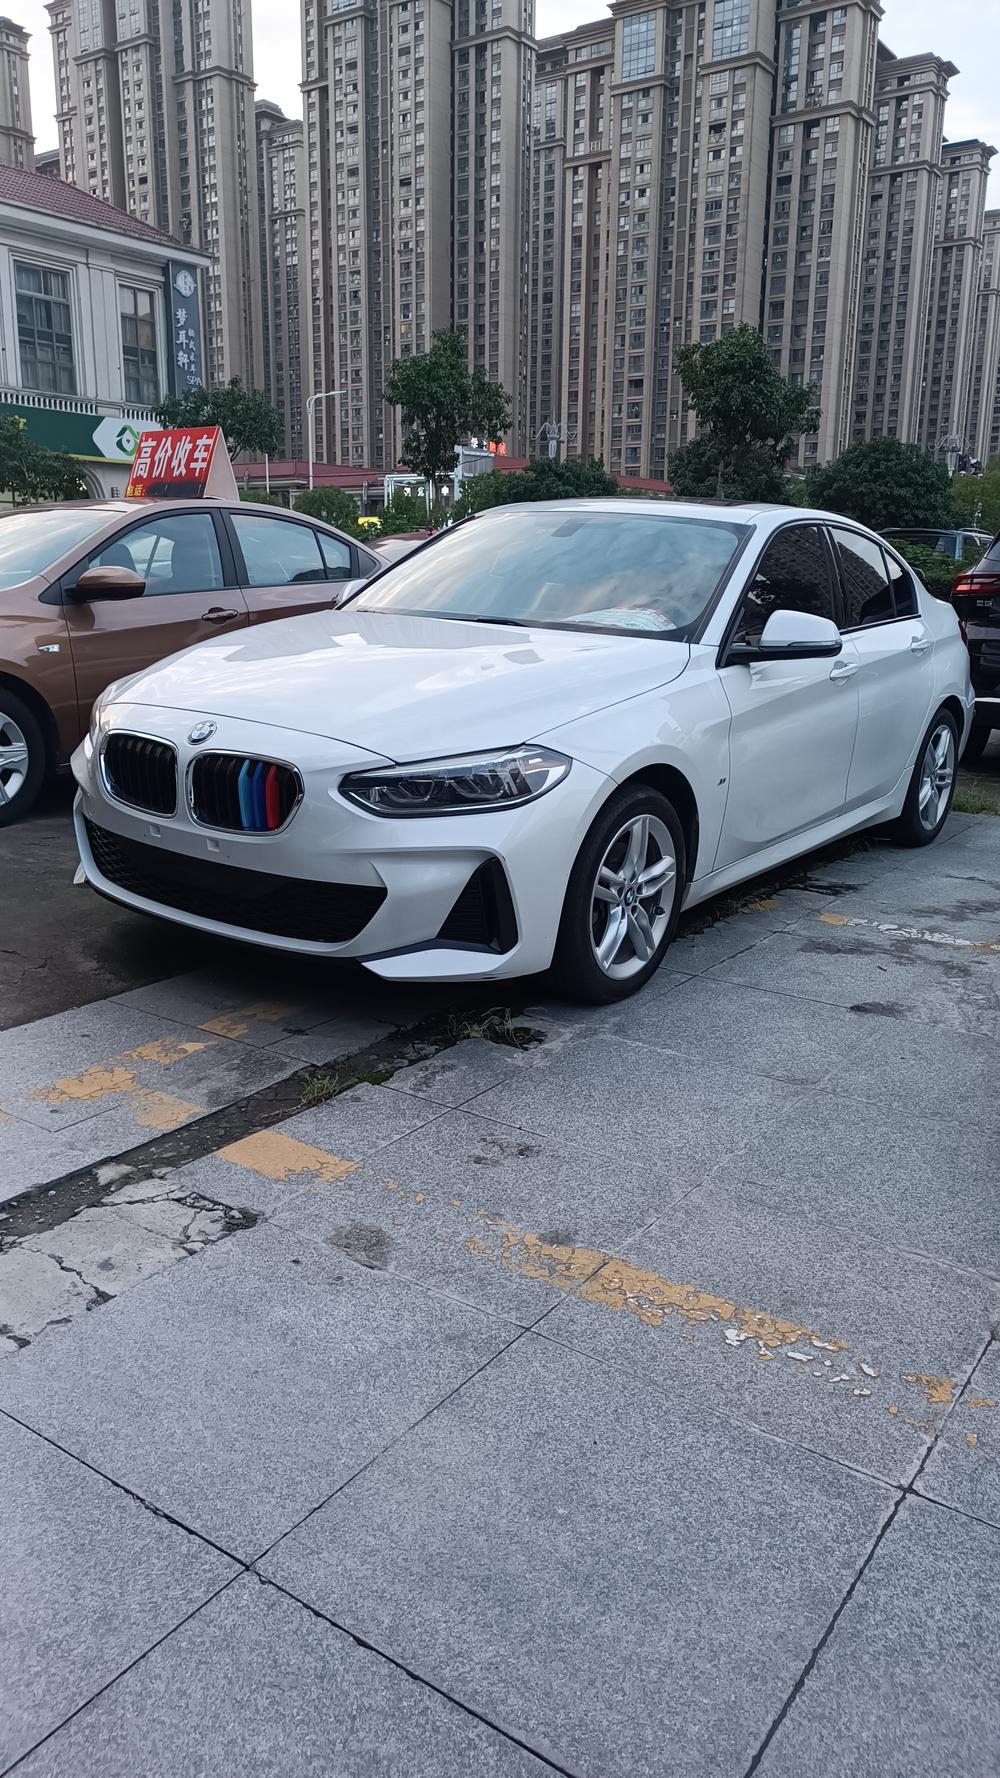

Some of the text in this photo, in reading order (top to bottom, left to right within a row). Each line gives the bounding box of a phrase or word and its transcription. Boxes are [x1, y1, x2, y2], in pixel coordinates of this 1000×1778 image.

[186, 375, 202, 386] SPA
[133, 434, 213, 478] 高价收车
